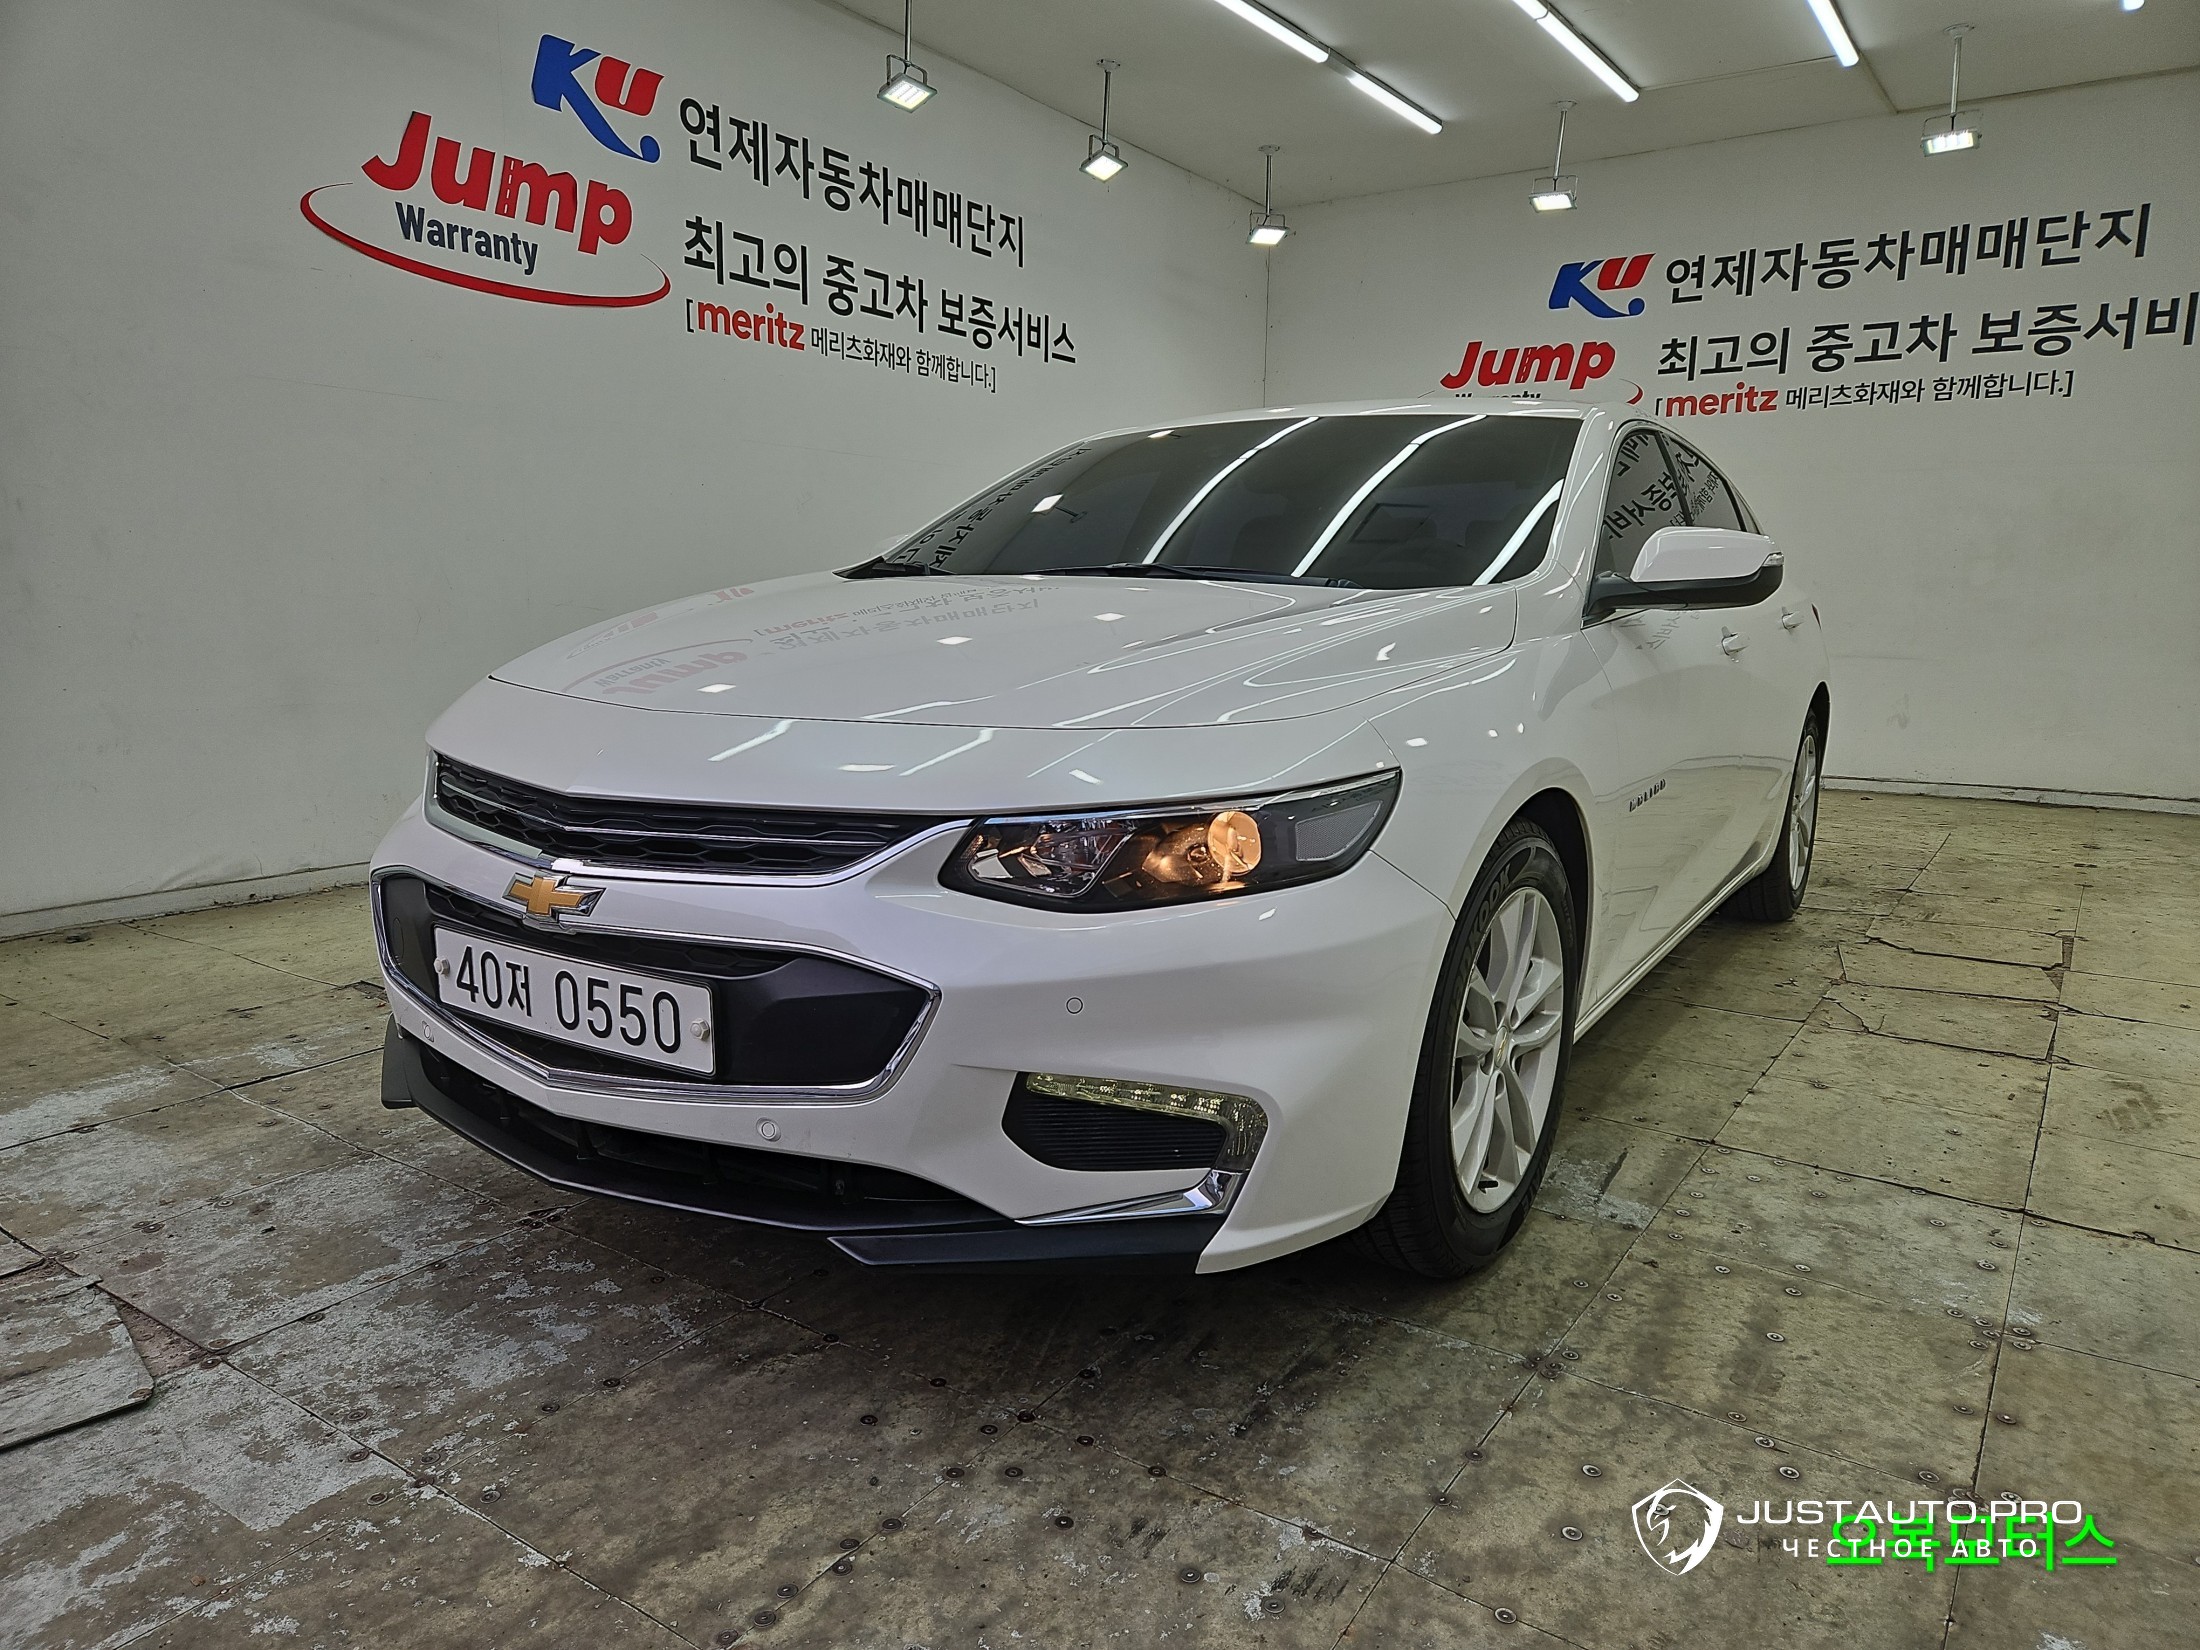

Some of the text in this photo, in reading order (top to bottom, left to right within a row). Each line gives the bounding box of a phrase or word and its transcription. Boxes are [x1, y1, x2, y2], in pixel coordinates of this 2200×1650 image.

[361, 110, 632, 255] Jump
[679, 97, 1025, 268] 연제자동차매매단지
[395, 201, 538, 276] Warranty
[1665, 203, 2152, 305] 연제자동차매매단지
[684, 215, 1077, 365] 최고의 중고차 보증서비스
[1657, 291, 2200, 382] 최고의 중고차 보증서비
[811, 326, 912, 373] 메리츠화재와
[1440, 341, 1616, 390] Jump
[1786, 379, 1925, 411] 메리츠화재와
[456, 945, 681, 1053] 40저 0550
